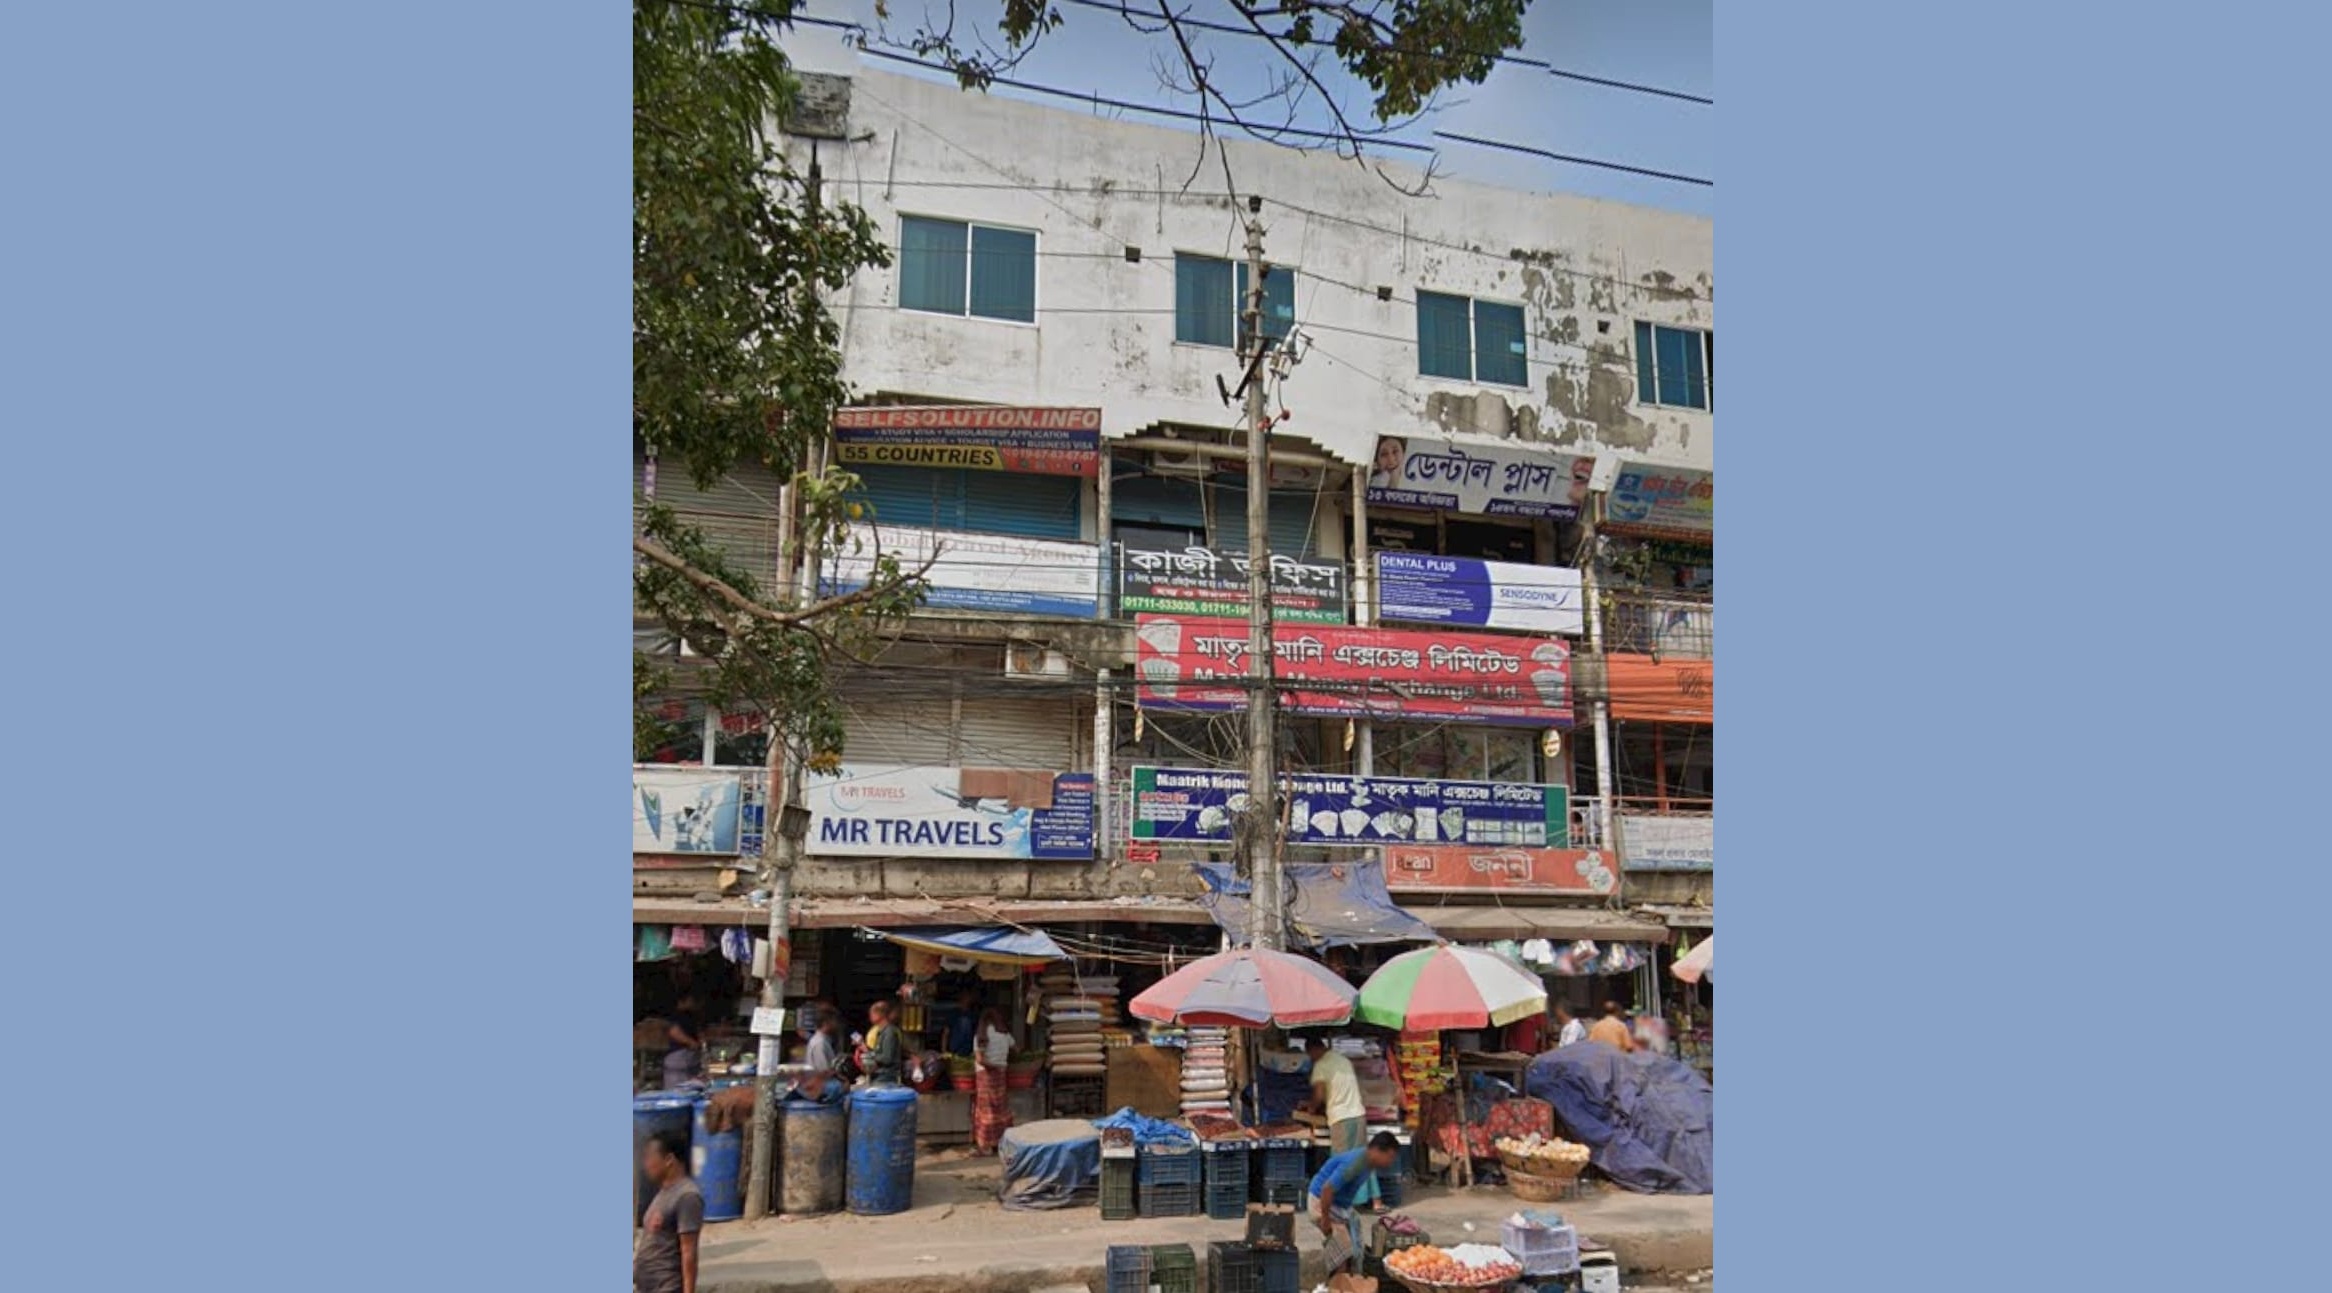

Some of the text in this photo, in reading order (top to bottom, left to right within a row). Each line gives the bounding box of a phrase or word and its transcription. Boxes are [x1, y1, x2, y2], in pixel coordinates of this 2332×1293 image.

[837, 409, 1099, 429] SELFSOLUTION.INFO
[1010, 429, 1069, 439] APPLICATION
[845, 446, 995, 465] 55 COUNTRIES
[1404, 447, 1556, 494] ডেন্টাল প্লাস
[1126, 546, 1223, 579] কাজী
[1381, 556, 1457, 572] DENTAL PLUS
[1500, 588, 1558, 602] SENSODYNE
[1428, 643, 1521, 673] লিমিটেড
[862, 786, 905, 799] TRAVELS
[1156, 773, 1210, 787] Maatrik
[1325, 781, 1349, 794] Ltd.
[820, 816, 1005, 846] MR TRAVELS
